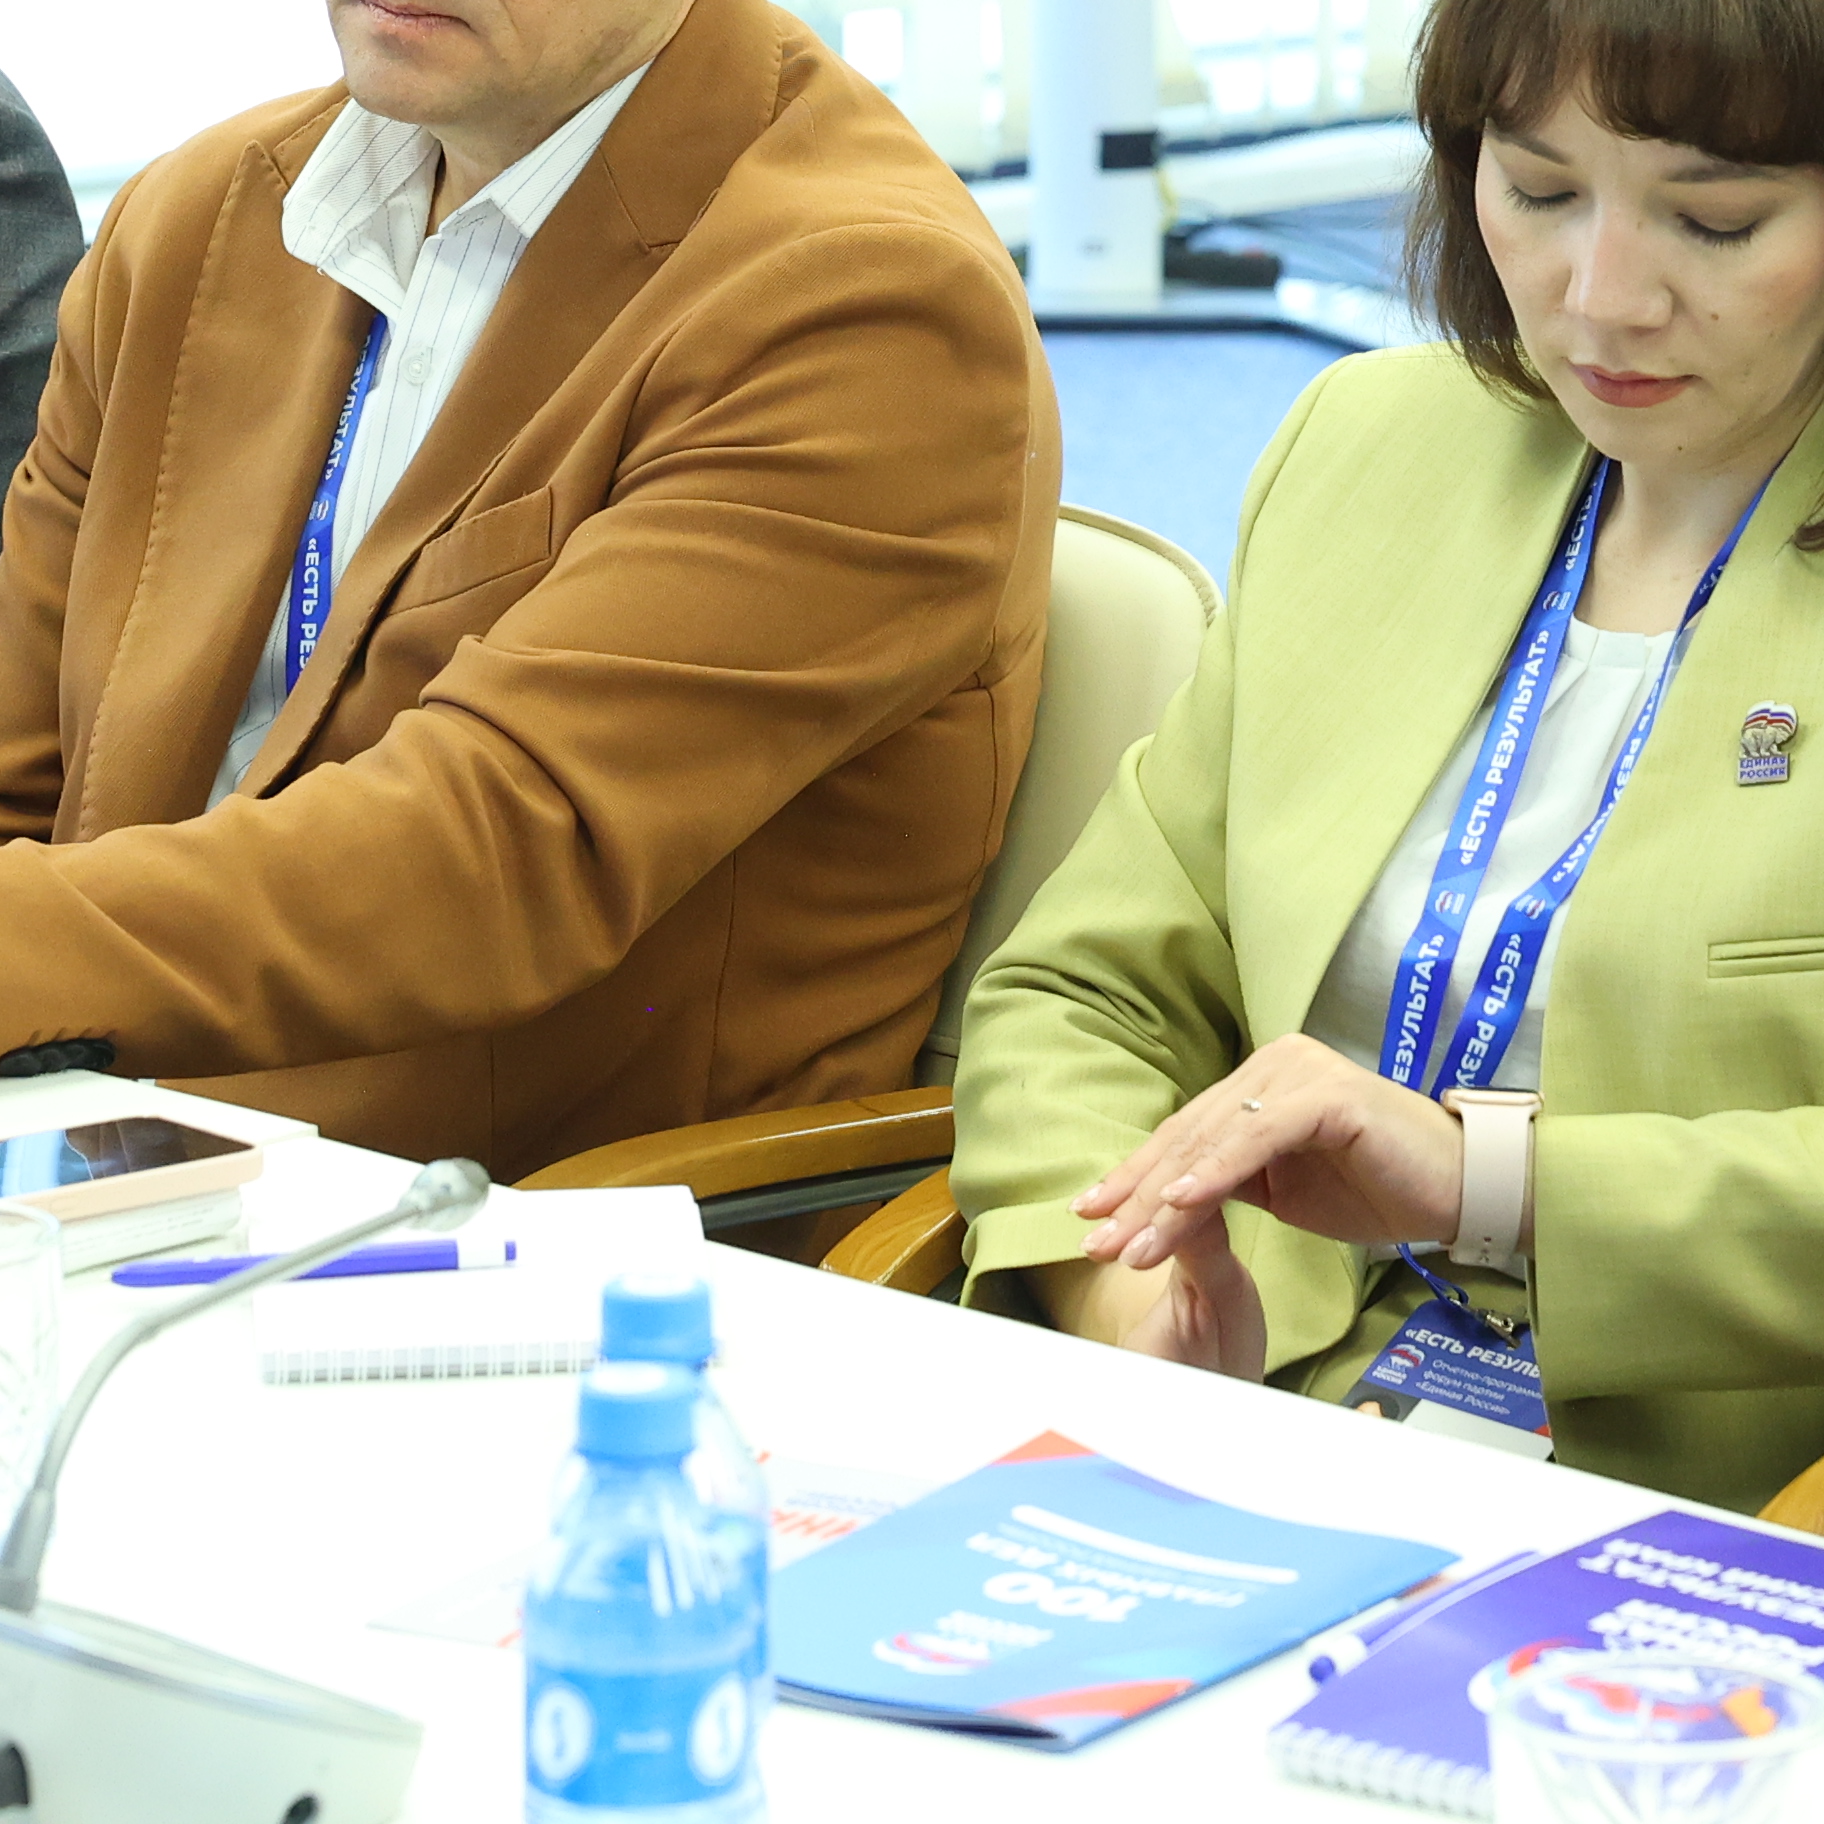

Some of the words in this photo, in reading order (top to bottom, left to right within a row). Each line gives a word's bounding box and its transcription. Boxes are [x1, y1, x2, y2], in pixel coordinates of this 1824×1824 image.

[301, 537, 319, 616] «ЕСТЬ
[1458, 787, 1497, 867] «ЕСТЬ
[1485, 629, 1550, 787] РЕЗУЛЬТАТ»
[1739, 757, 1787, 771] ЕДИНАЯ
[1391, 933, 1445, 1084] ЕЗУЛЬТАТ»
[1482, 933, 1523, 1016] «ЕСТЬ
[1405, 1328, 1465, 1356] «ЕСТЬ
[1466, 1345, 1542, 1379] РЕЗУЛЬ
[982, 1571, 1142, 1623] 100
